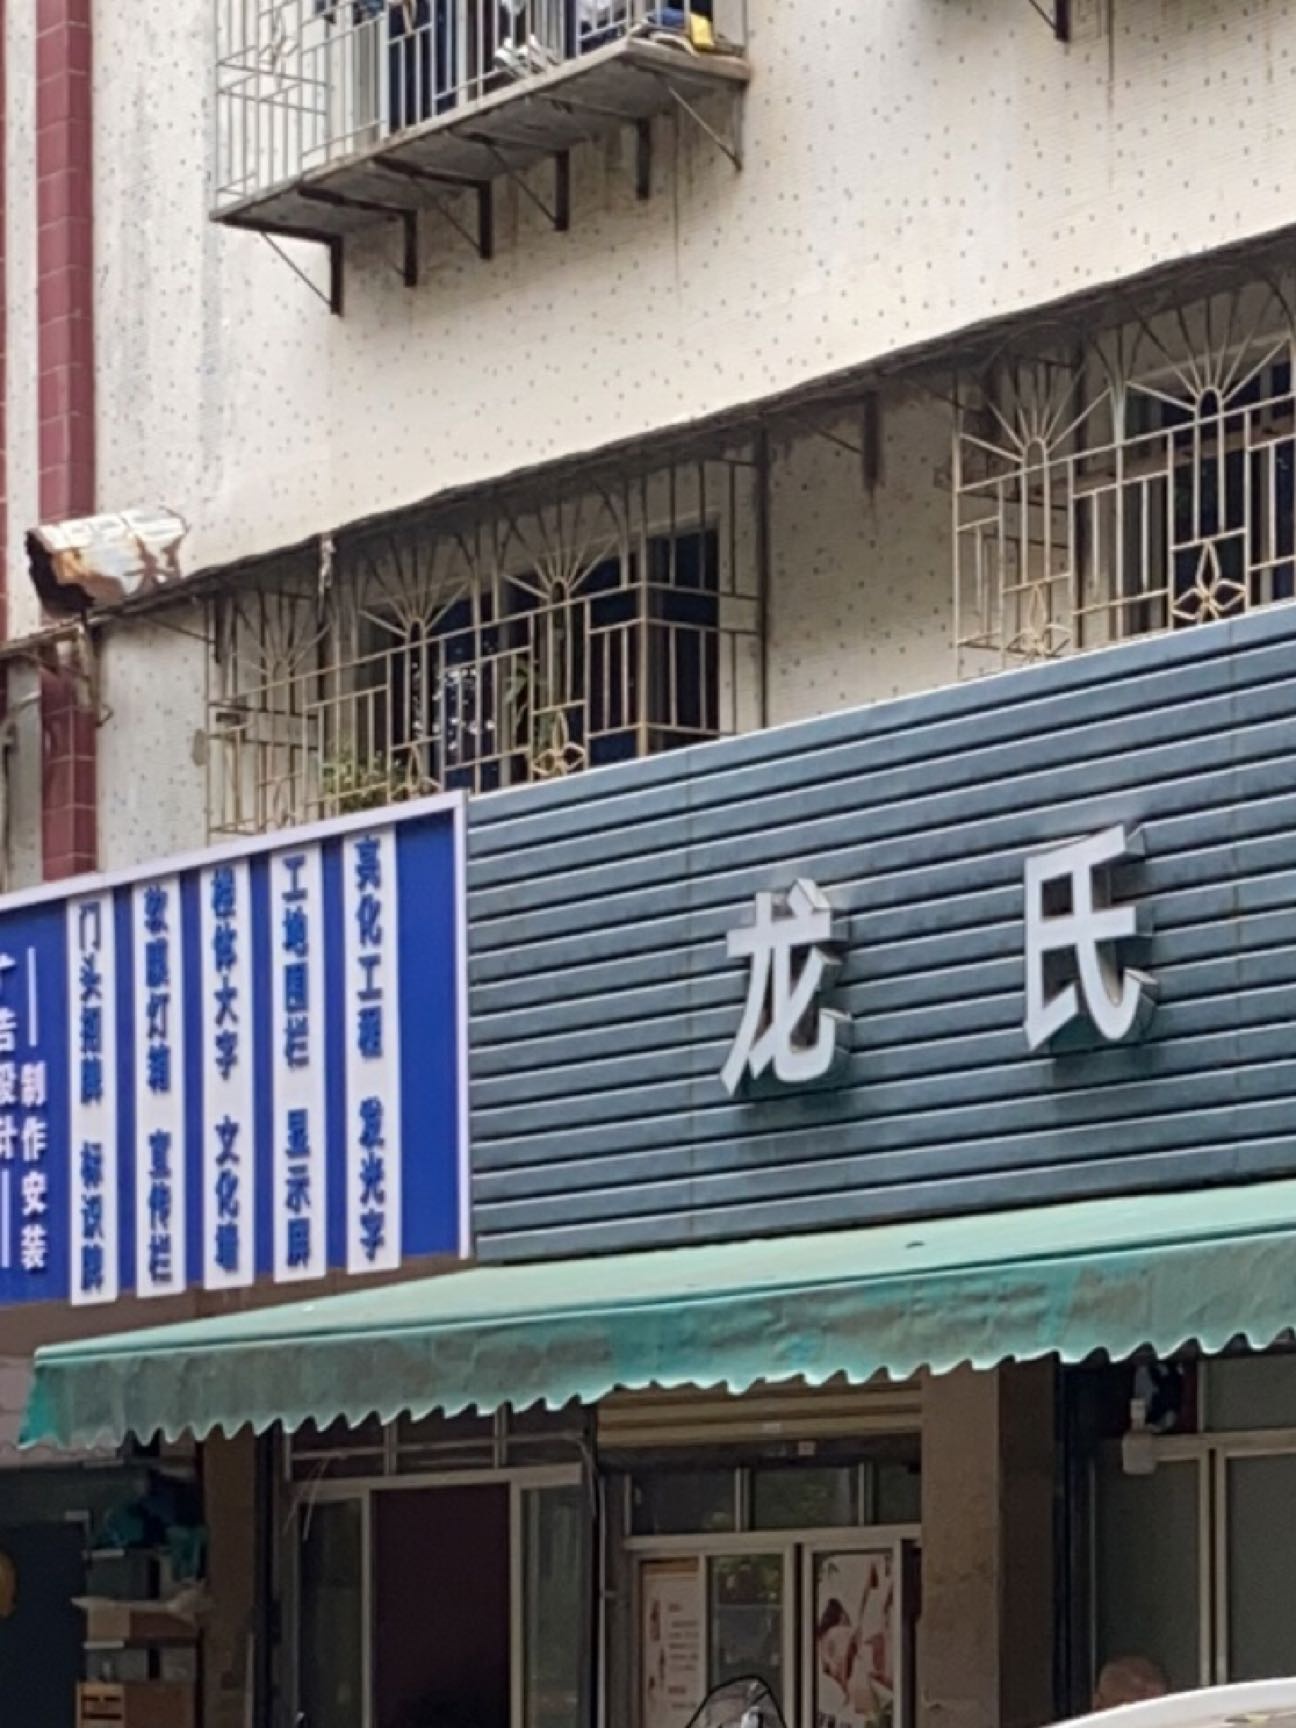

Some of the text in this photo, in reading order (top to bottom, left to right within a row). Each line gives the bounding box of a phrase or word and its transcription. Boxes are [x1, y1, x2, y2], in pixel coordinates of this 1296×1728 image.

[78, 902, 104, 1293] 门头招牌 标识牌
[351, 834, 386, 1263] 亮化工程 发光字
[20, 1061, 47, 1272] 制作安装
[147, 1129, 174, 1285] 宣传栏
[214, 1115, 241, 1273] 文化墙
[284, 1108, 312, 1268] 显示屏
